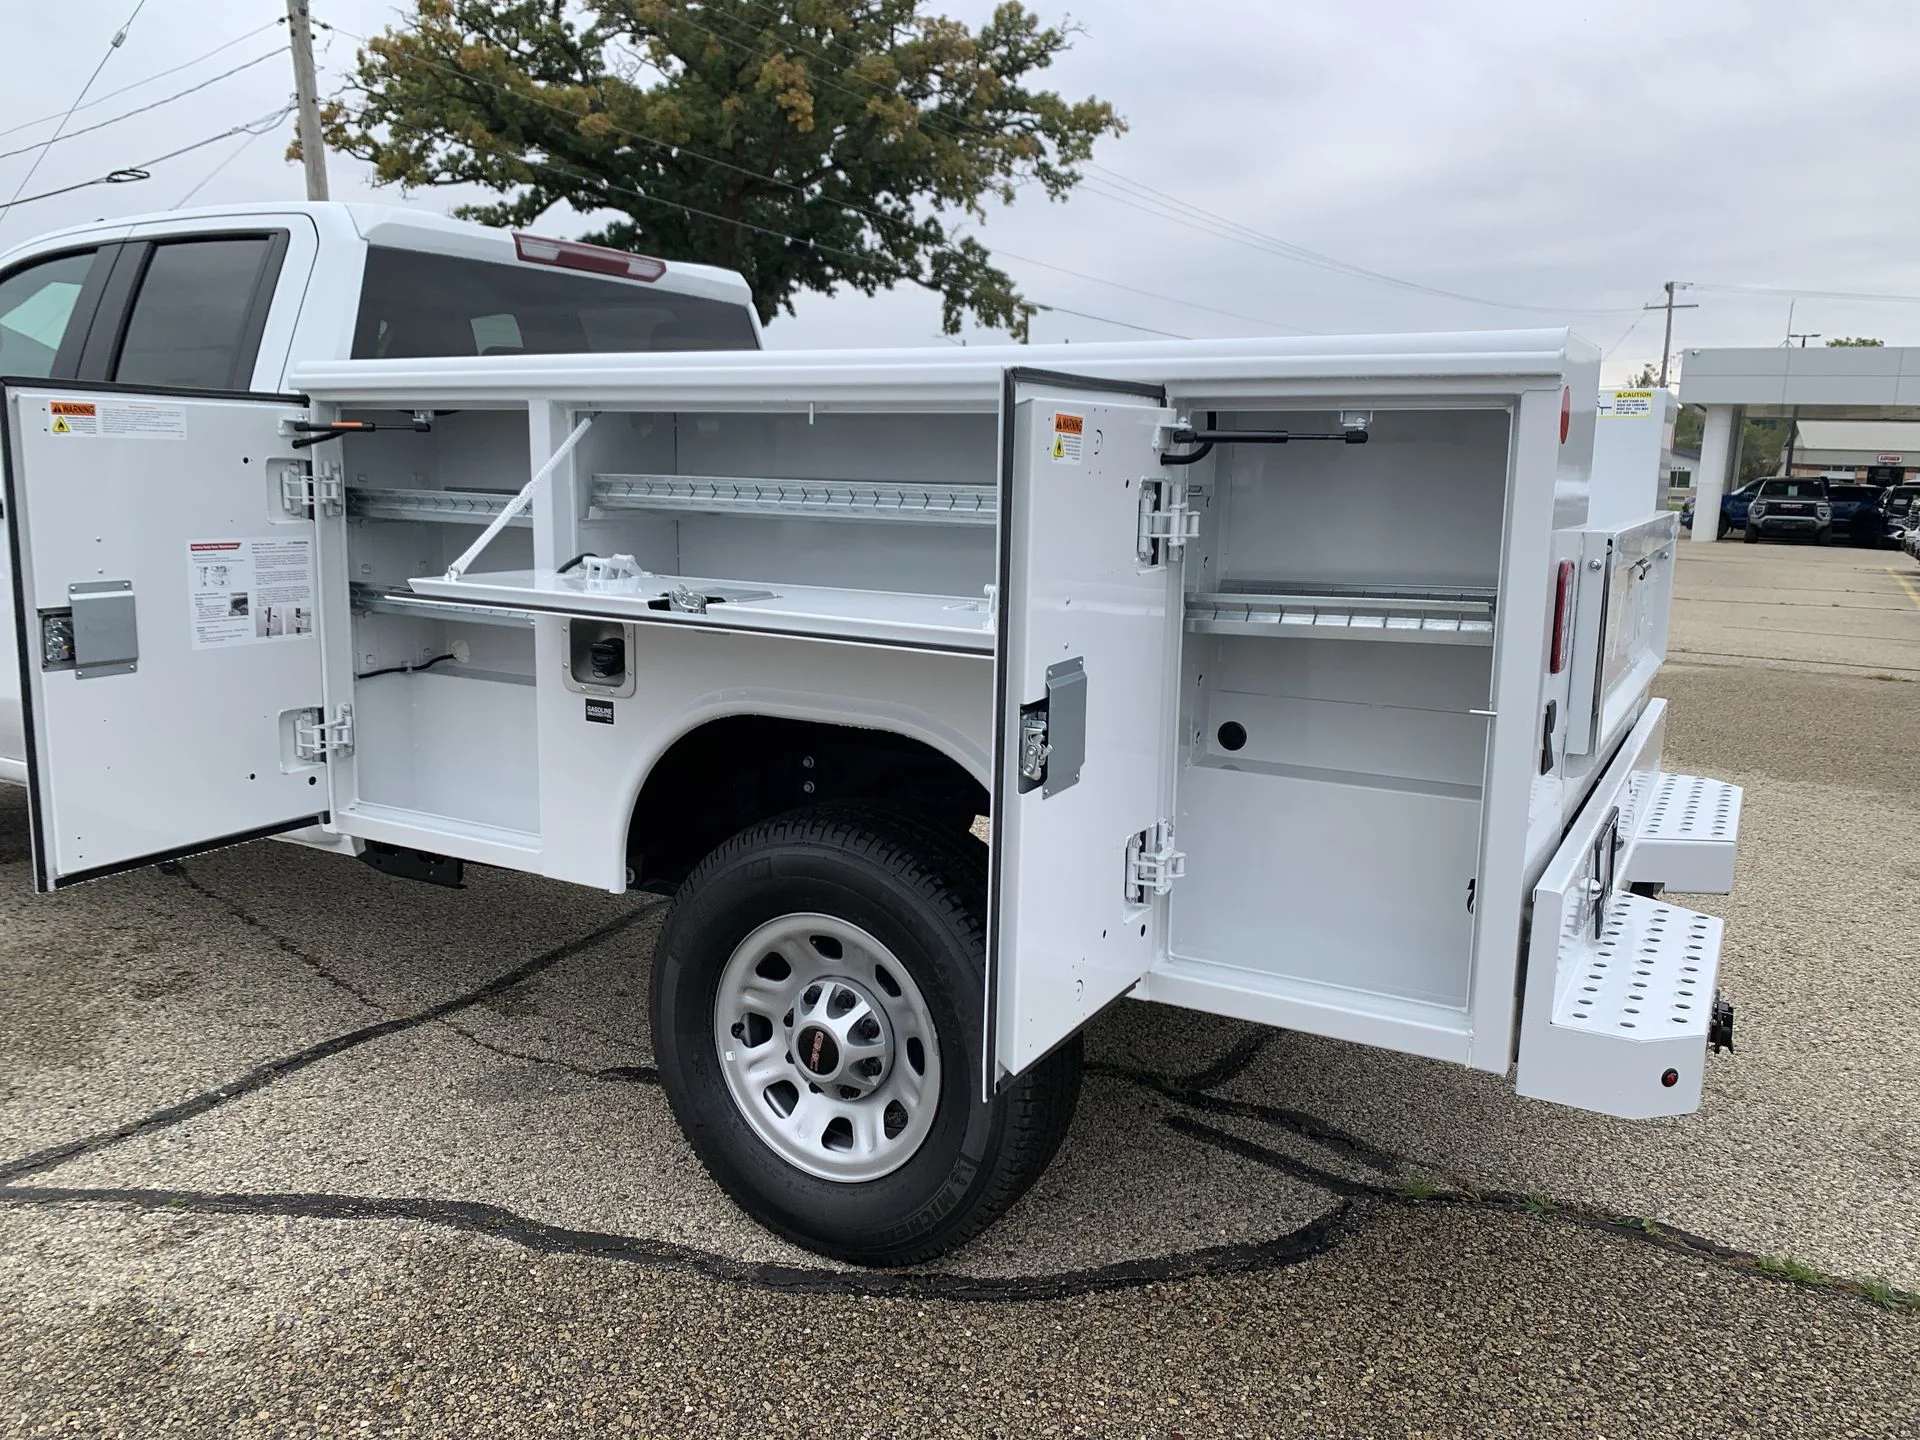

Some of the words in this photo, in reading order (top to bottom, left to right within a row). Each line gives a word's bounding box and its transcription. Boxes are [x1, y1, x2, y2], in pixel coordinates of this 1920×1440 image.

[63, 403, 95, 415] WARNING
[1063, 417, 1082, 433] WARNING
[587, 705, 612, 716] GASOLINE
[810, 1031, 824, 1072] GMC
